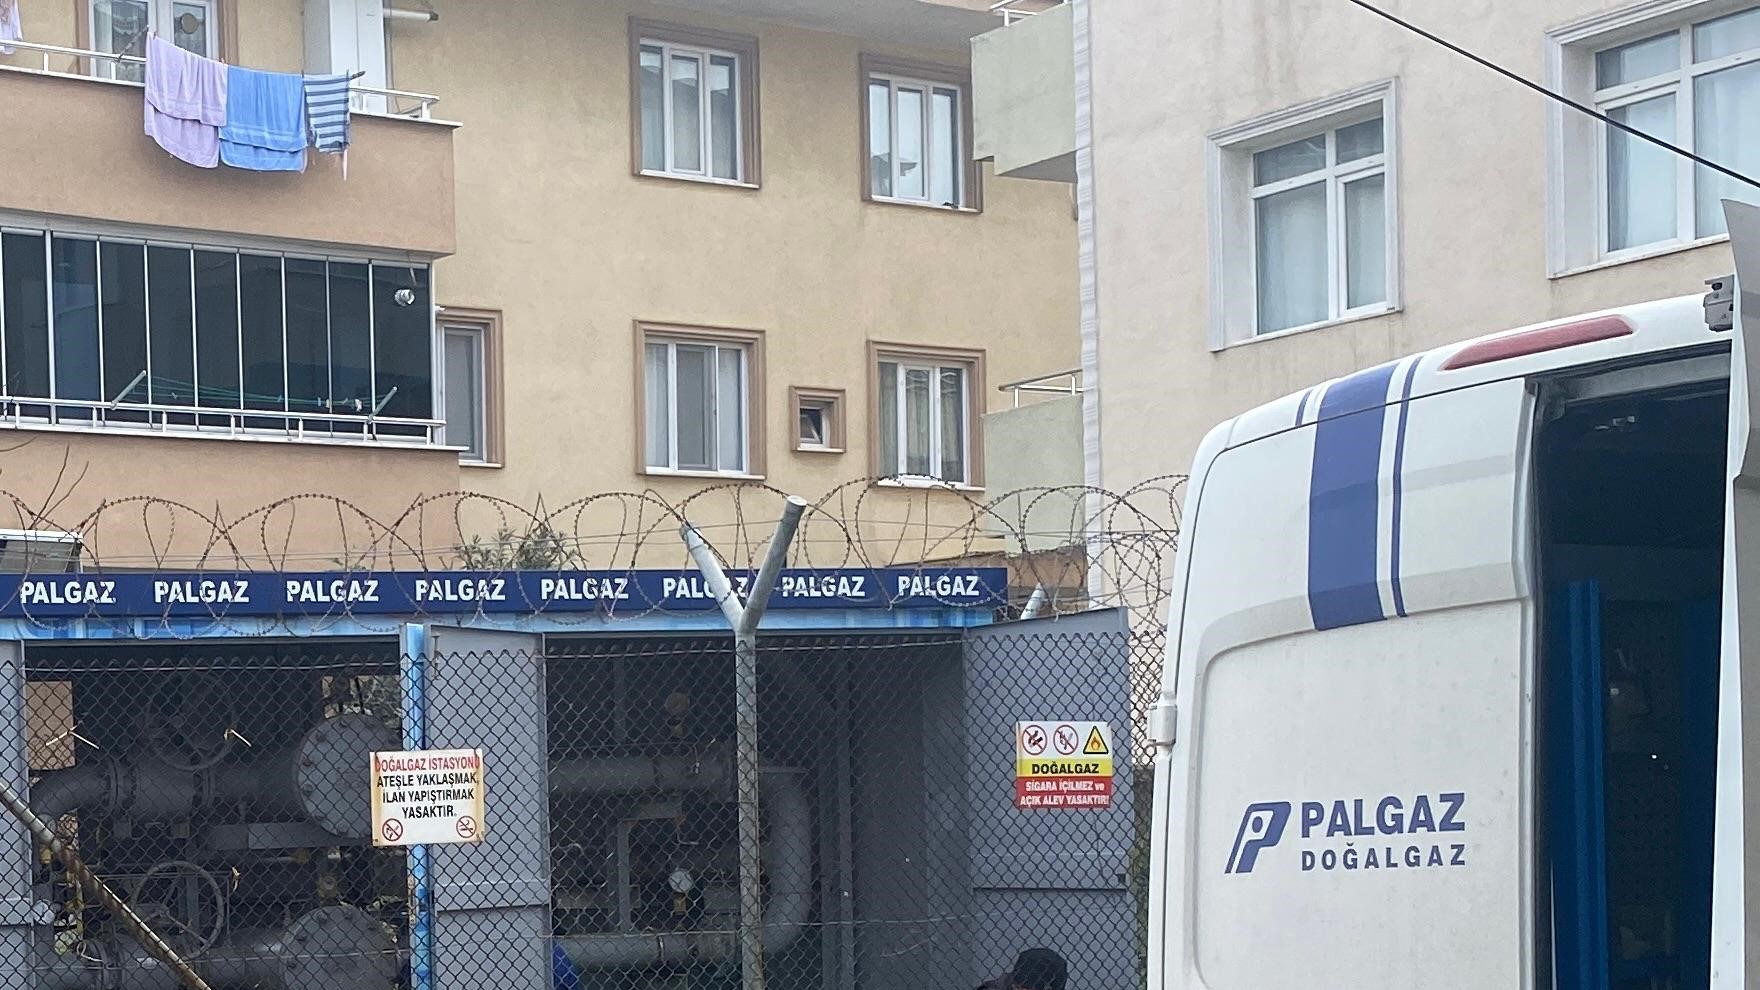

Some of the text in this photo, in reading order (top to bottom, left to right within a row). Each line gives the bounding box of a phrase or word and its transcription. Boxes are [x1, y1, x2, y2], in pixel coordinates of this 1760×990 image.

[20, 581, 116, 604] PALGAZ
[154, 580, 249, 604] PALGAZ
[286, 579, 379, 603] PALGAZ
[415, 578, 506, 601] PALGAZ
[540, 578, 628, 600] PALGAZ
[782, 576, 865, 597] PALGAZ
[897, 574, 979, 596] PALGAZ
[374, 756, 426, 772] DOĞALGAZ
[1032, 761, 1099, 774] DOĞALGAZ
[377, 775, 414, 790] ATEŞLE
[408, 788, 475, 804] YAPIŞTIRMAK
[1043, 795, 1064, 805] ALEV
[1301, 792, 1465, 838] PALGAZ
[1301, 842, 1465, 871] DOĞALGAZ
